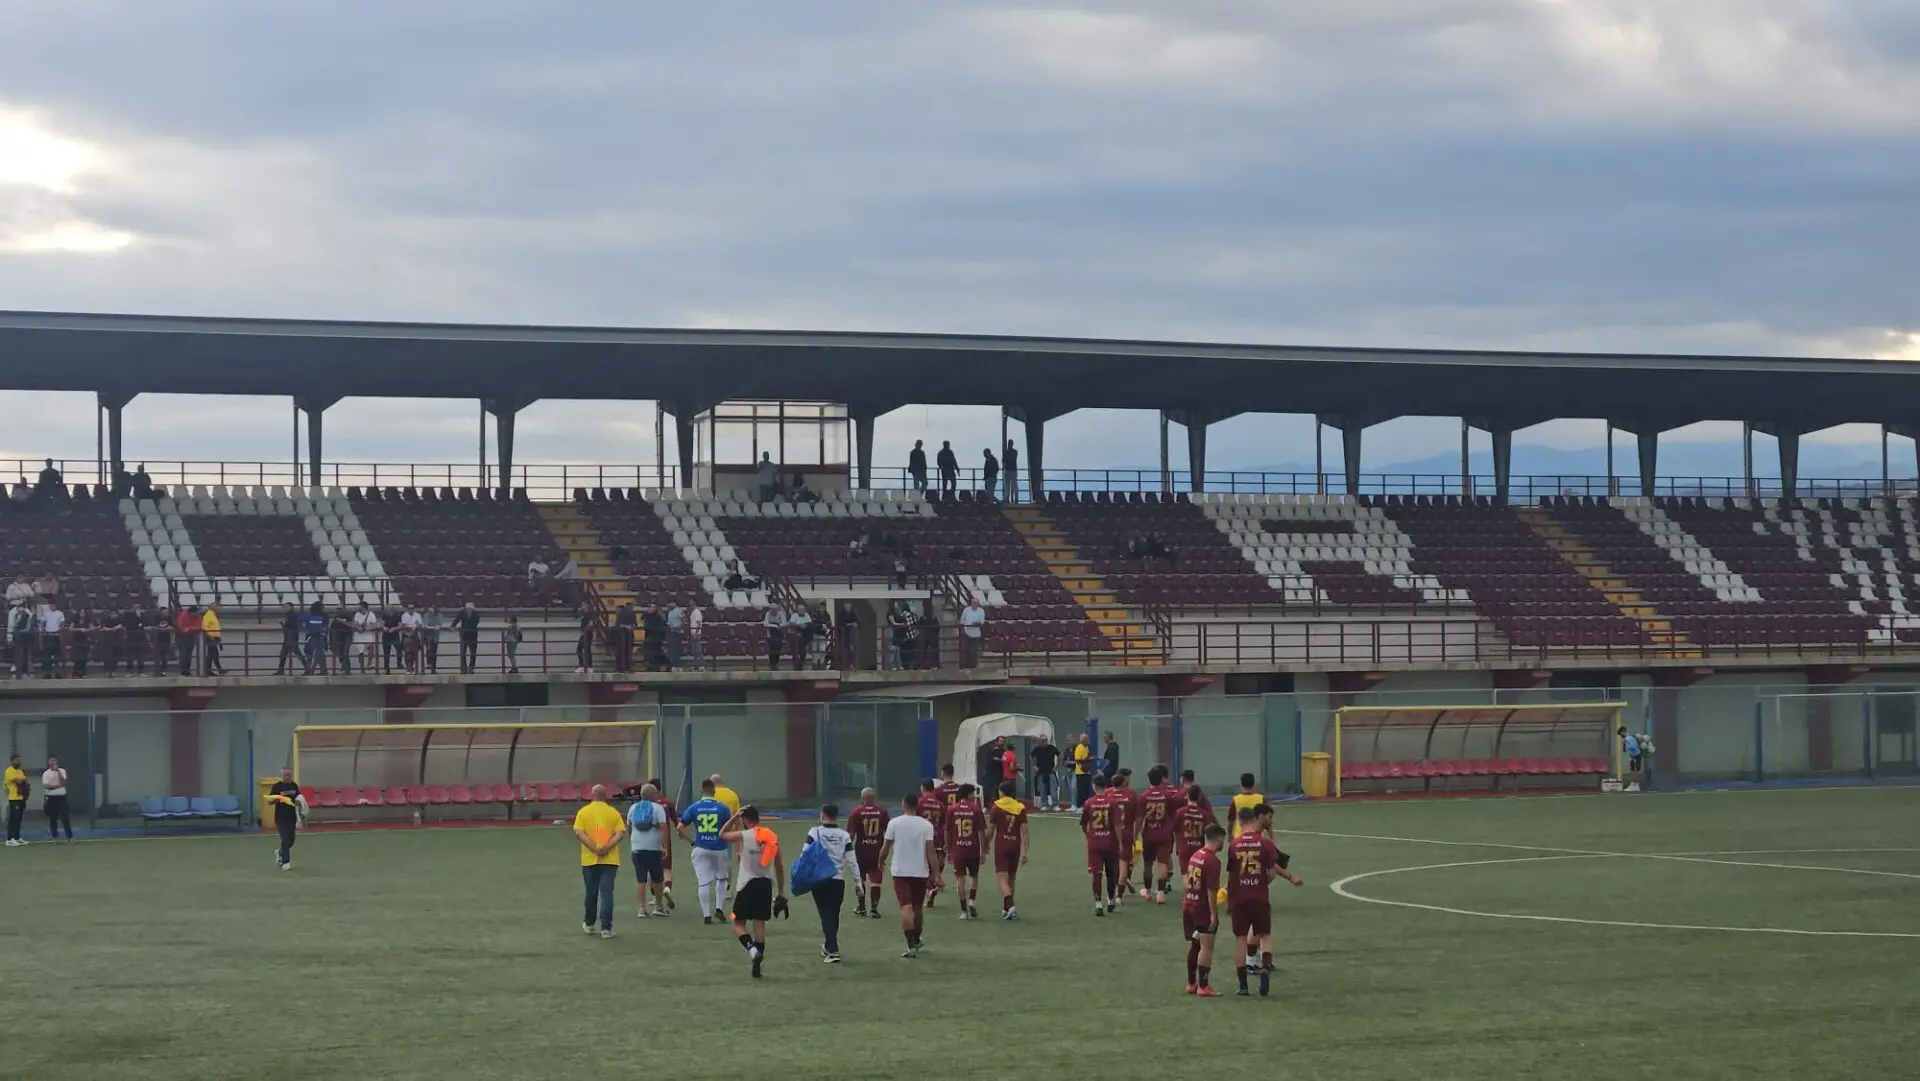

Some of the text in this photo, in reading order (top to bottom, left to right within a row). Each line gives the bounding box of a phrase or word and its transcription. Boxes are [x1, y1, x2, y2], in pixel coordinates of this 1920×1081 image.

[697, 813, 718, 832] 32
[862, 818, 880, 836] 10
[1005, 814, 1016, 833] 7
[1091, 809, 1109, 829] 21
[1235, 850, 1261, 875] 75
